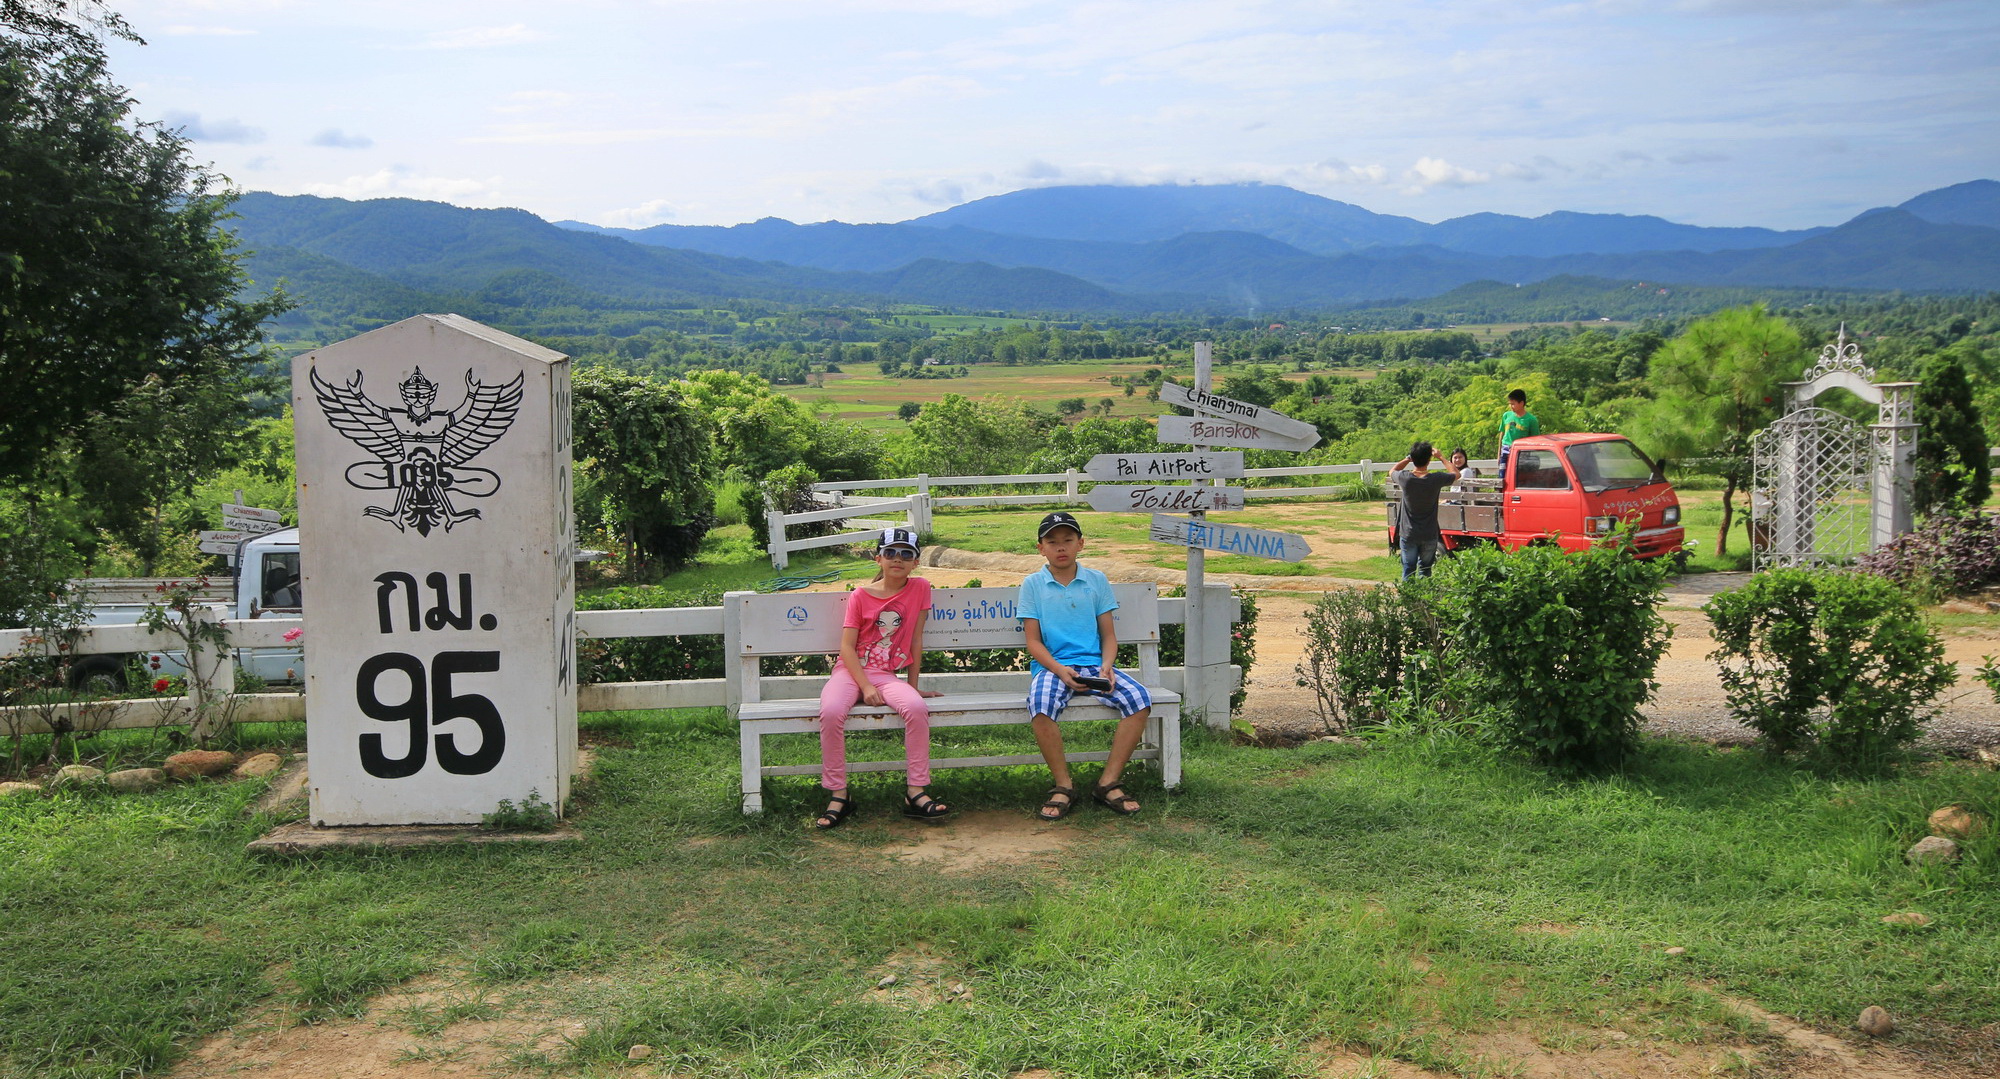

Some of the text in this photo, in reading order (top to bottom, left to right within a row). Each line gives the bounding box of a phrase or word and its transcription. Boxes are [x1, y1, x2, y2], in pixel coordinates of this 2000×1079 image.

[1187, 388, 1258, 419] Chiangmai
[1190, 421, 1261, 440] Bangkok
[383, 461, 455, 489] 1095
[1117, 458, 1137, 476] Pai
[559, 465, 567, 536] 3
[1130, 486, 1206, 510] Toilet
[1187, 521, 1285, 558] PAI LANNA
[373, 571, 498, 634] กม.
[558, 607, 573, 697] 47
[356, 651, 506, 779] 95
